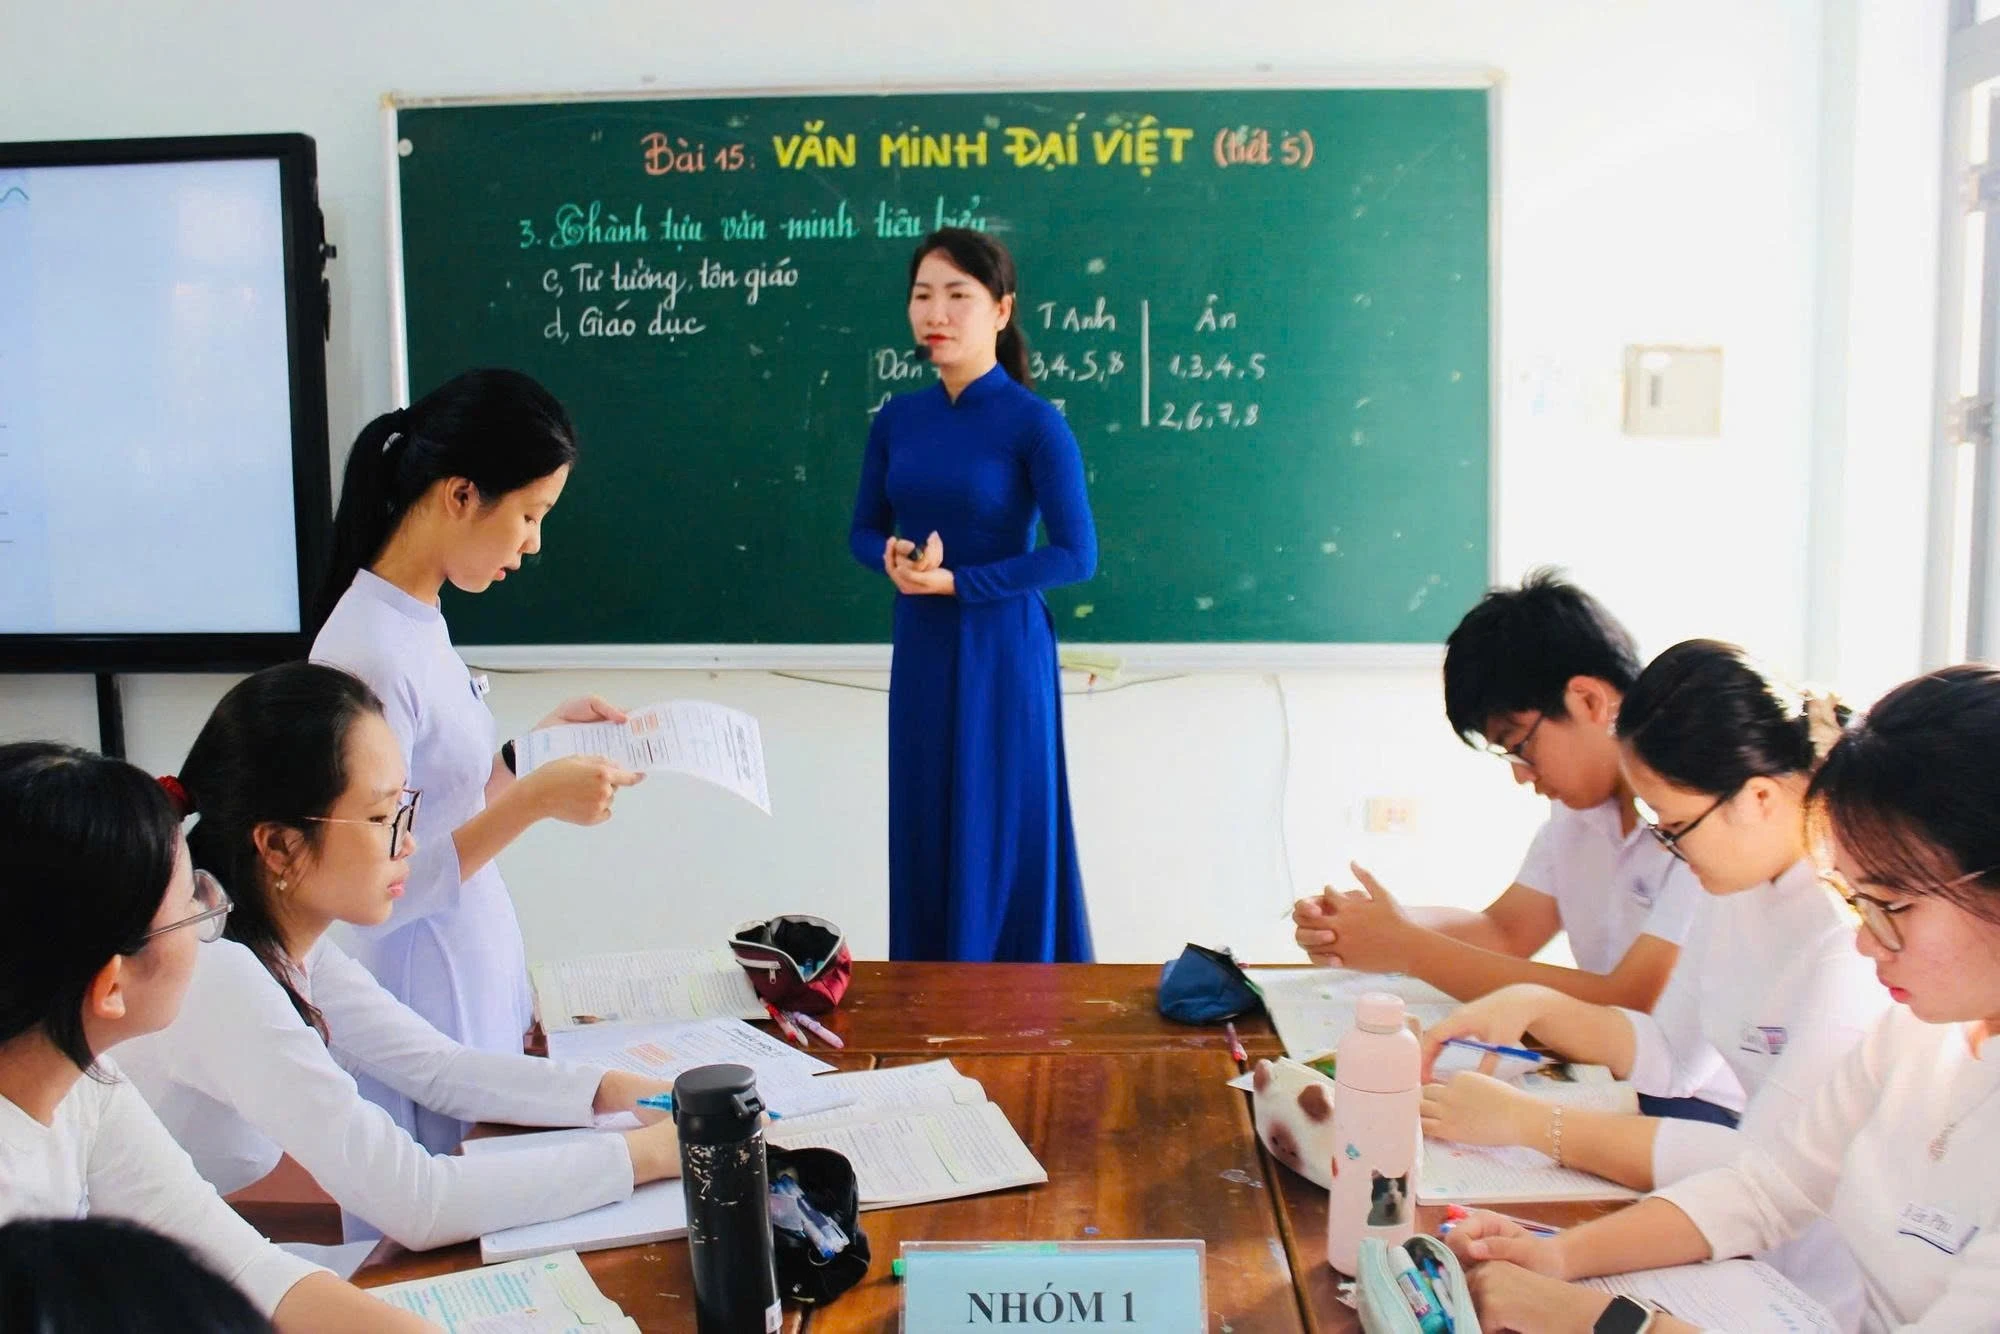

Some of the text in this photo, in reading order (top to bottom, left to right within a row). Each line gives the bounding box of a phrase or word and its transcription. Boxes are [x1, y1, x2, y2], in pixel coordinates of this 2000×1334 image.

[640, 132, 705, 176] Bài
[773, 119, 857, 170] VĂN
[1280, 129, 1315, 169] 5)
[519, 218, 542, 249] 3.
[550, 200, 650, 249] Thành
[720, 209, 767, 242] văn
[874, 200, 923, 238] tiêu
[570, 262, 604, 293] Tư
[699, 257, 739, 289] tôn
[743, 256, 799, 306] giáo
[543, 298, 707, 345] d, Giáo dục
[1037, 295, 1117, 333] T Anh
[967, 1282, 1137, 1324] NHÓM 1
